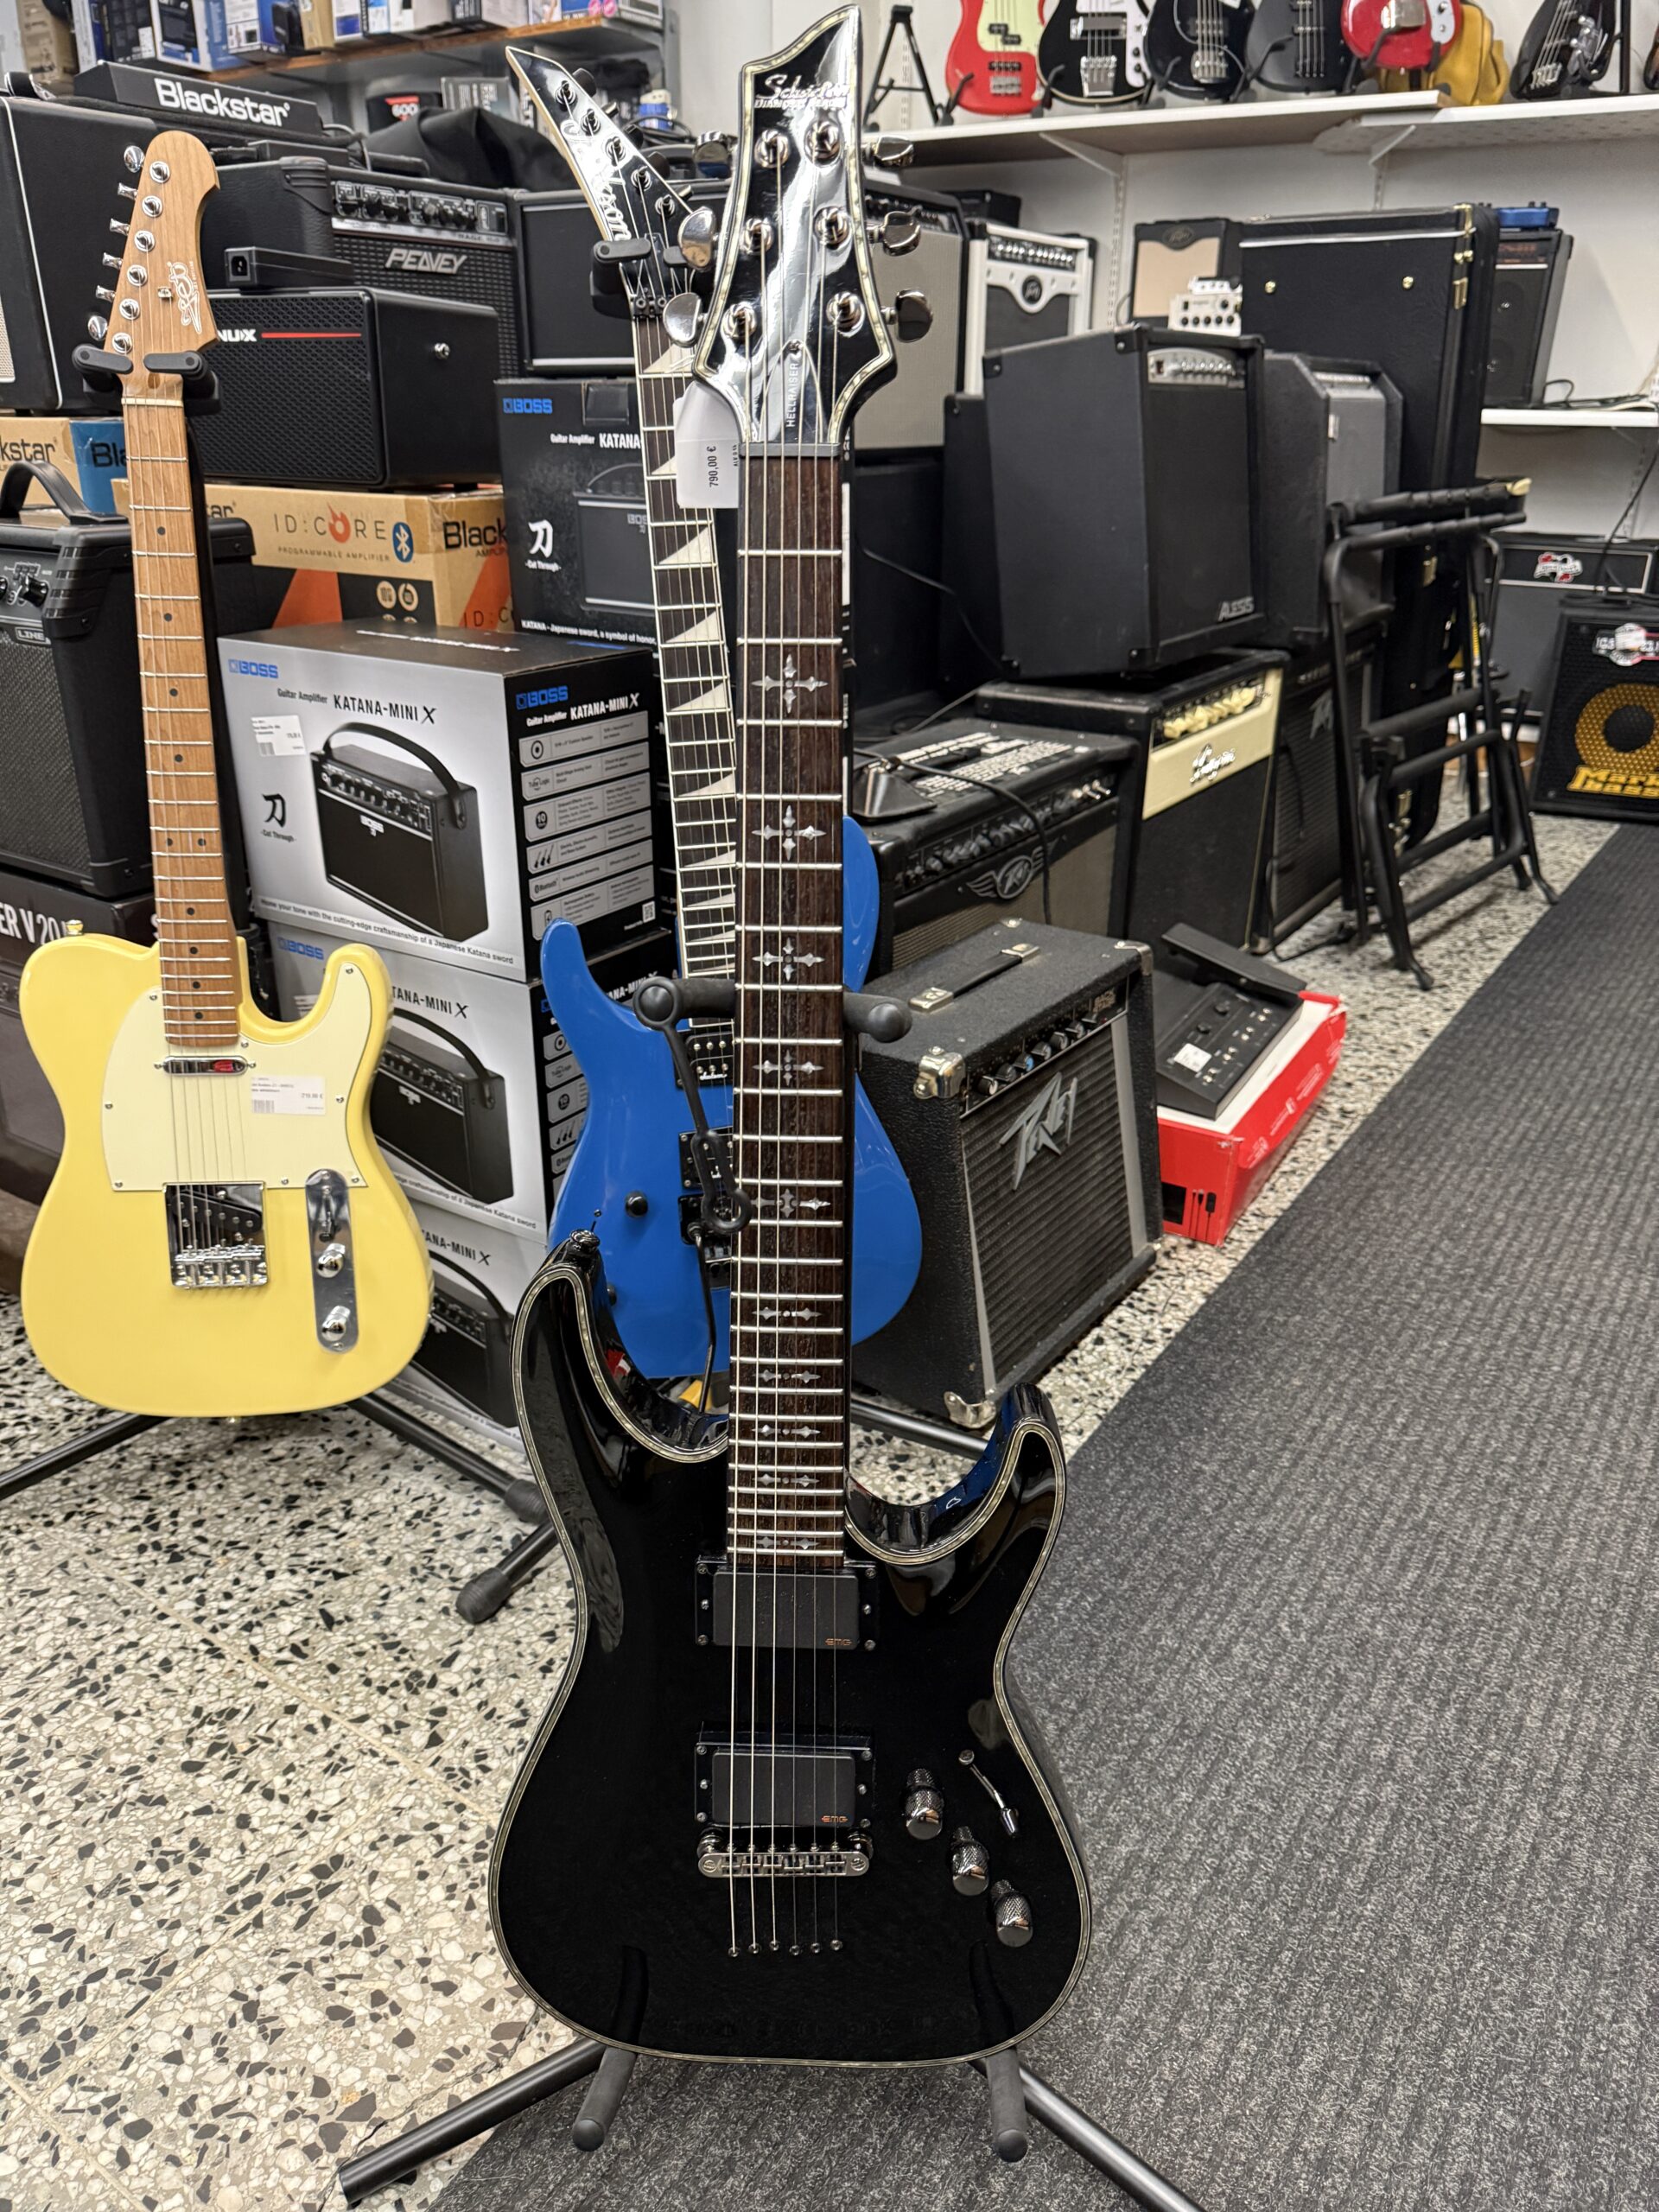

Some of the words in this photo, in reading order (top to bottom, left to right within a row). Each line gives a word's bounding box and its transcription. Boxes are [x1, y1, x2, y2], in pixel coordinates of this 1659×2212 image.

[154, 78, 289, 127] Blackstar
[391, 103, 419, 118] 600
[385, 248, 467, 274] PEAVEY
[217, 328, 257, 342] NUX
[513, 398, 553, 415] BOSS
[785, 363, 798, 428] HELLRAISER
[0, 435, 56, 464] kstar
[550, 433, 568, 444] Guitar
[569, 434, 595, 446] Amplifier
[92, 441, 129, 468] Bla
[707, 455, 720, 488] 790,00
[207, 504, 234, 518] ar
[442, 518, 508, 550] Black
[528, 519, 554, 558] 刀
[278, 546, 343, 559] PROGRAMMABLE
[346, 551, 390, 563] AMPLIFIER
[18, 630, 44, 641] LINE
[521, 619, 546, 631] KATANA
[550, 624, 579, 636] Japanese
[579, 629, 600, 639] sword,
[605, 631, 628, 641] symbol
[628, 632, 636, 642] of
[636, 633, 658, 645] honor,
[238, 660, 279, 679] BOSS
[277, 688, 297, 700] Guitar
[298, 691, 327, 704] Amplifier
[334, 694, 419, 721] KATANA-MINI
[421, 705, 437, 725] X
[528, 685, 569, 708] BOSS
[526, 716, 543, 727] Guitar
[543, 711, 568, 725] Amplifier
[570, 696, 629, 721] KATANA-MINI
[629, 692, 640, 709] X
[262, 793, 286, 828] 刀
[20, 908, 35, 943] V
[36, 913, 61, 945] 20
[278, 902, 292, 912] your
[294, 906, 307, 915] tone
[308, 909, 321, 918] with
[322, 912, 332, 921] the
[334, 916, 372, 931] cutting-edge
[373, 925, 418, 943] craftsmanship
[435, 939, 466, 953] Japanese
[467, 947, 491, 959] Katana
[493, 954, 513, 964] sword
[288, 939, 324, 960] BOSS
[454, 1001, 469, 1019] X
[494, 1210, 516, 1222] Katana
[517, 1217, 537, 1230] sword
[477, 1250, 492, 1266] X
[825, 1637, 853, 1646] EMG
